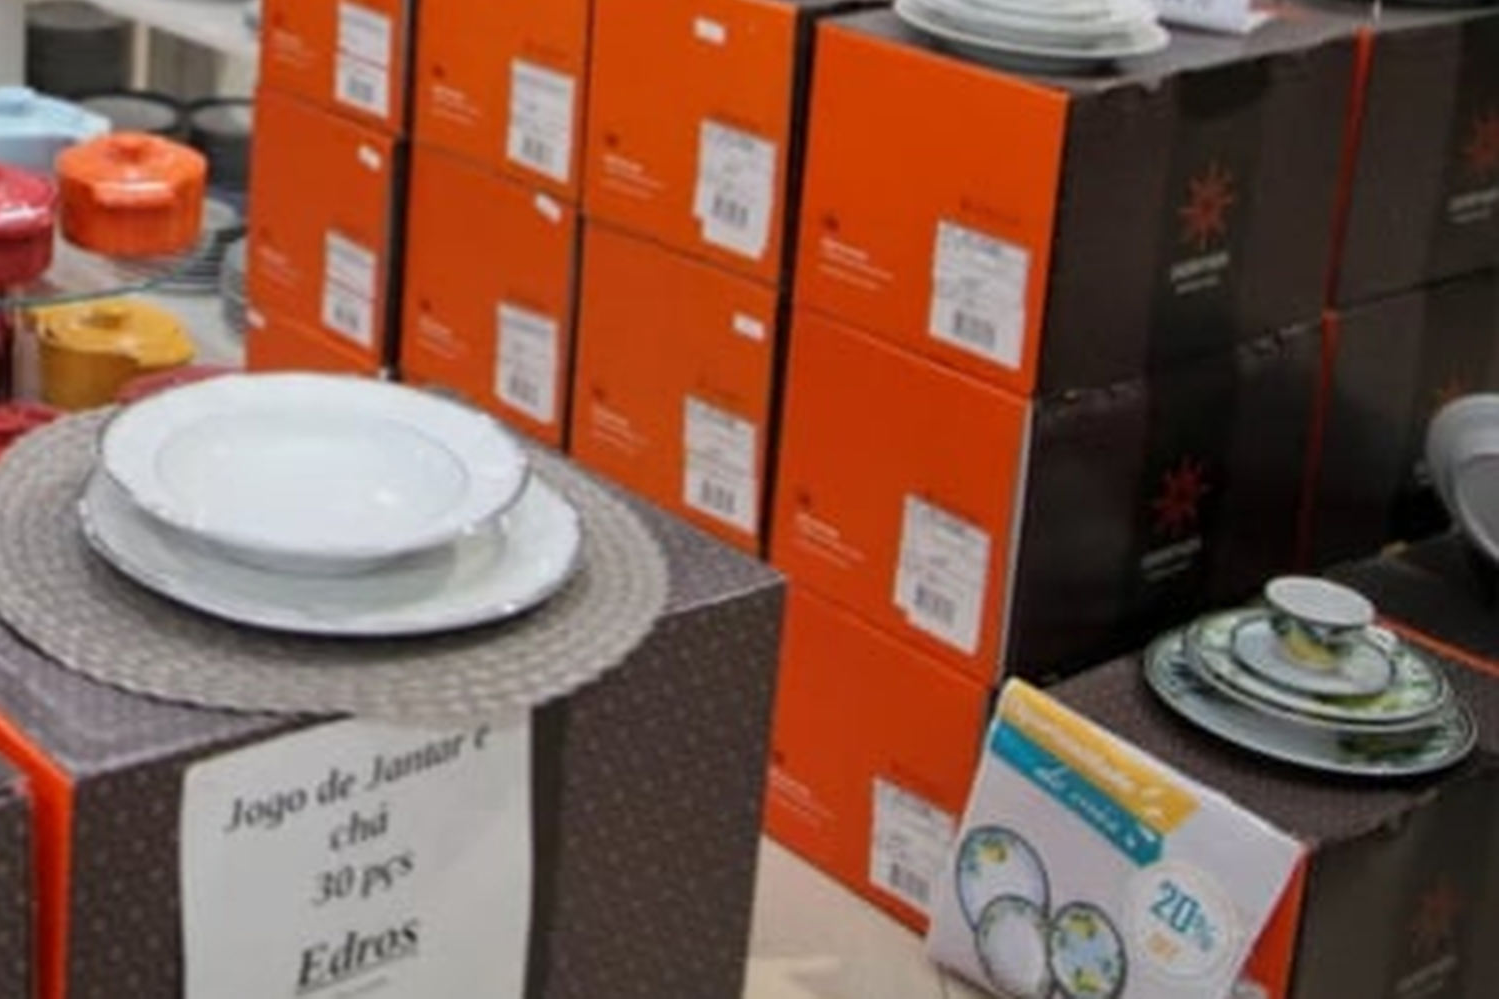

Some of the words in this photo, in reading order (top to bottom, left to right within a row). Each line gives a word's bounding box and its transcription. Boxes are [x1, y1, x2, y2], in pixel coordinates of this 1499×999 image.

[225, 789, 307, 833] Jogo
[315, 768, 357, 806] de
[365, 730, 466, 791] Jantar
[328, 801, 389, 853] chá
[312, 866, 355, 907] 30
[297, 918, 419, 990] Edros
